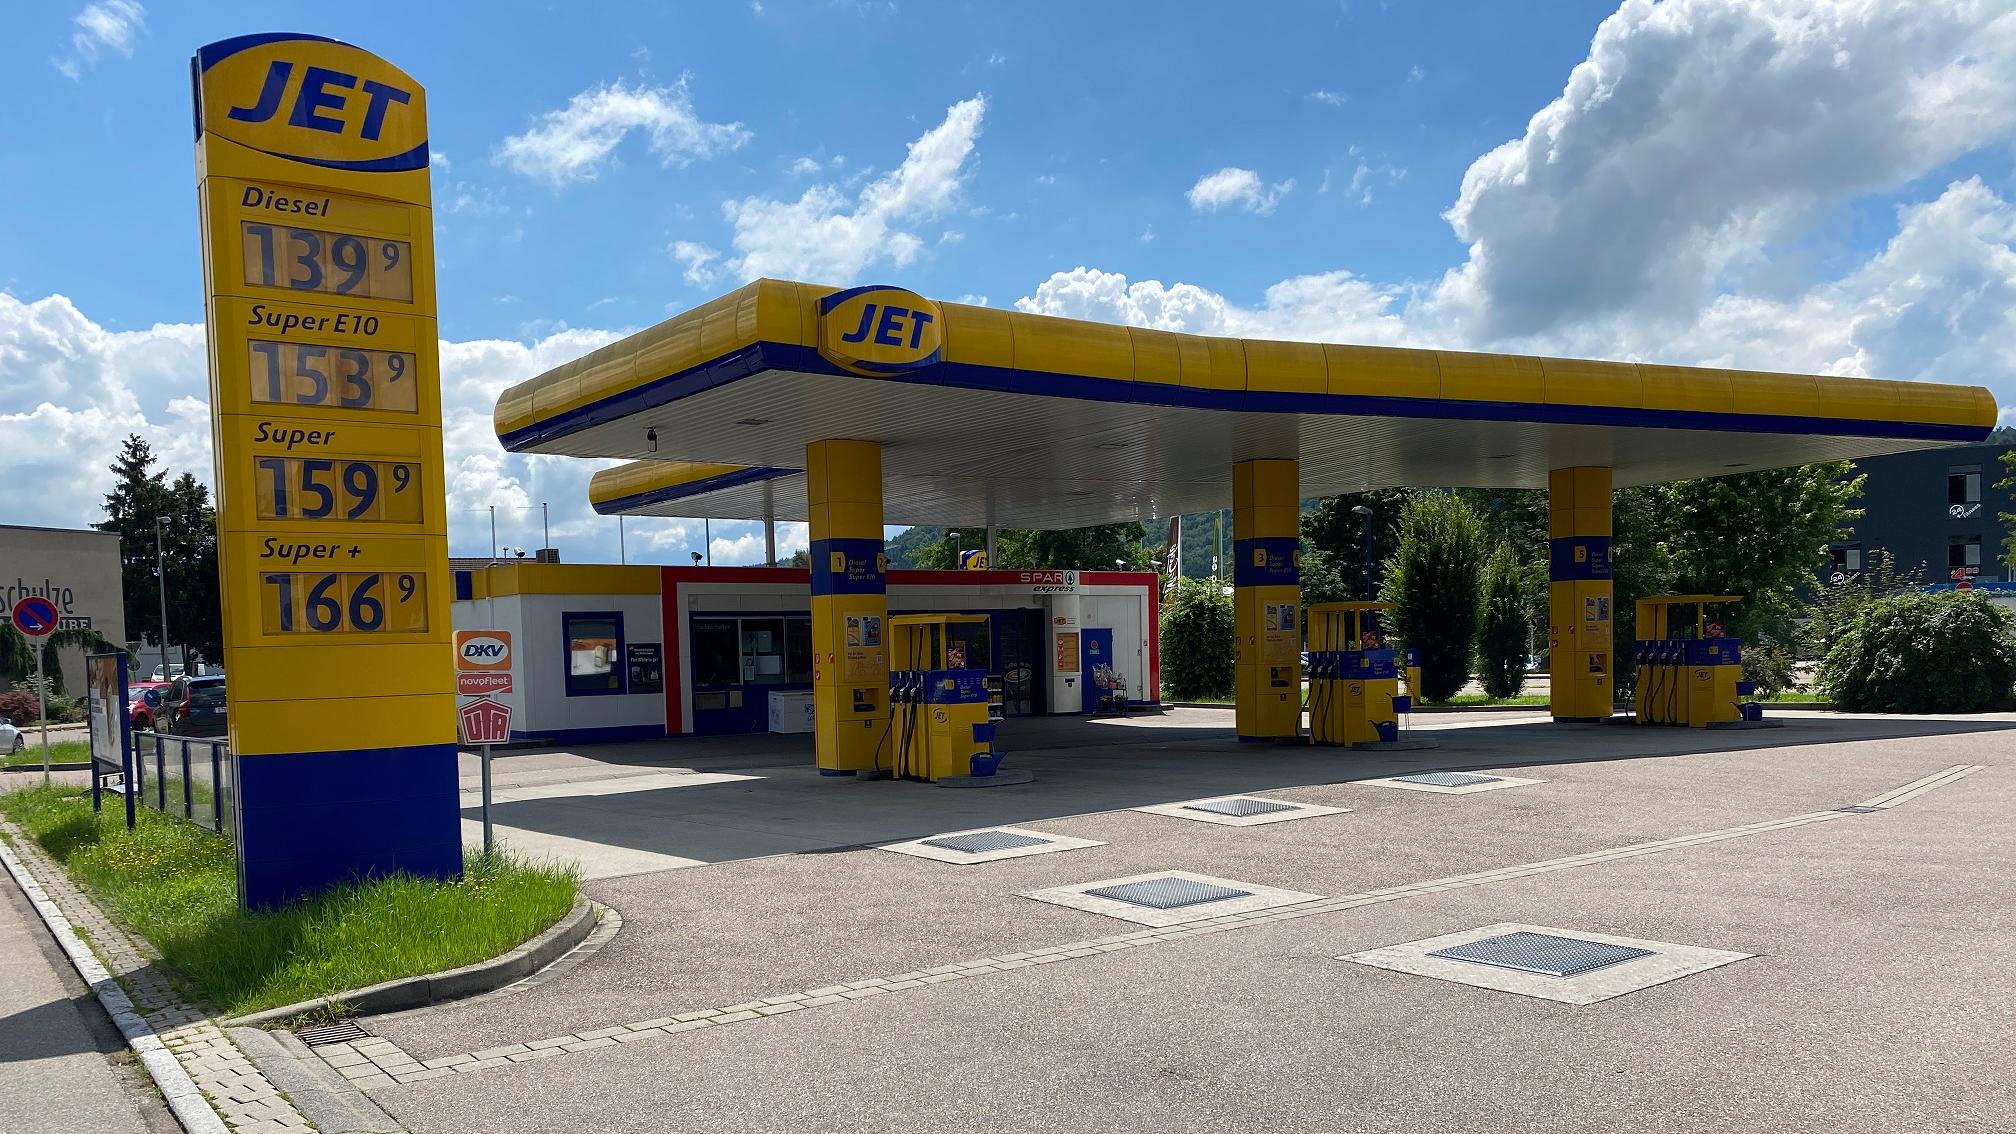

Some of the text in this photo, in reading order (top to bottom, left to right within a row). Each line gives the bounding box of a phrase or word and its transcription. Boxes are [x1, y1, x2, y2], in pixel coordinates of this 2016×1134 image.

[227, 61, 411, 141] JET
[241, 186, 330, 217] Diesel
[247, 226, 400, 294] 139 9
[248, 305, 379, 335] Super E10
[841, 304, 933, 349] JET
[253, 343, 405, 408] 153 9
[254, 422, 335, 450] Super
[259, 459, 410, 520] 159 9
[260, 538, 341, 565] Super
[837, 556, 843, 568] 1
[1259, 553, 1264, 562] 3
[1580, 550, 1585, 559] 5
[1021, 572, 1063, 582] SPAR
[1033, 585, 1076, 593] express
[265, 574, 415, 632] 166 9
[464, 644, 504, 657] DKV
[461, 677, 508, 686] novofleet
[464, 709, 509, 740] UTA
